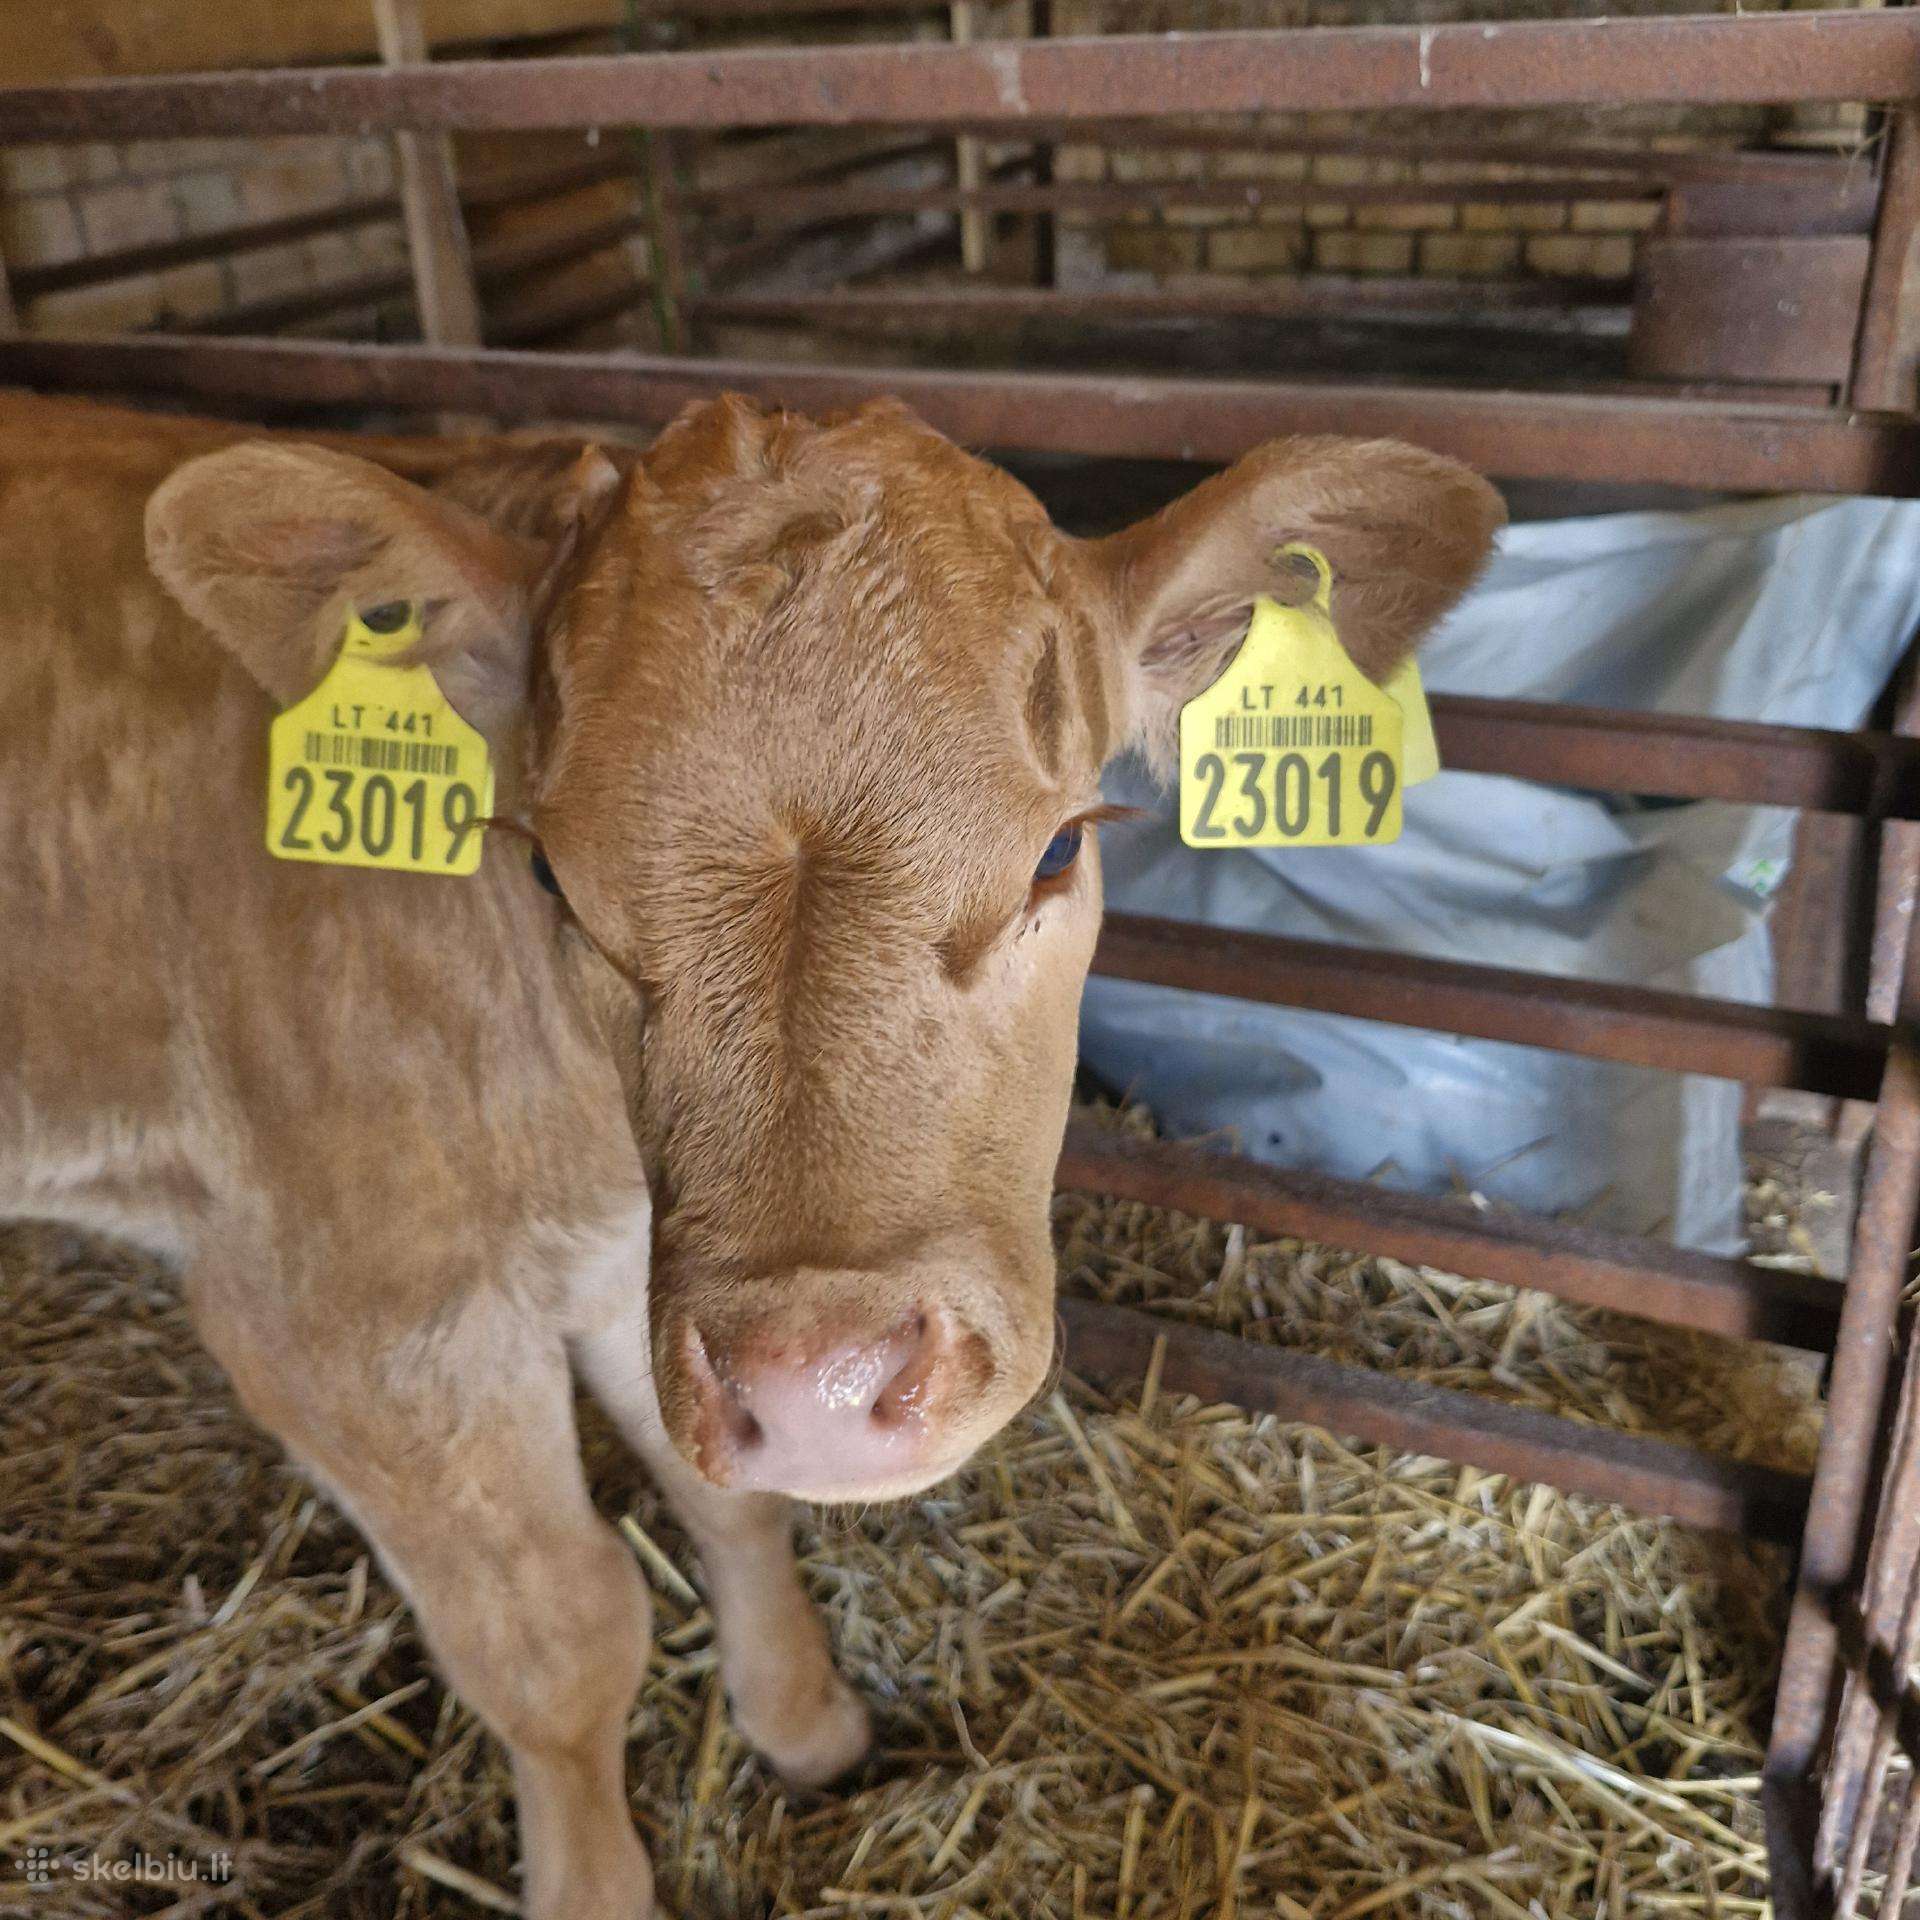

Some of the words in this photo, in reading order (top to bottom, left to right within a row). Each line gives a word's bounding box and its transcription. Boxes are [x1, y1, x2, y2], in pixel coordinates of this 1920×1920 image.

[332, 704, 366, 729] LT
[385, 710, 433, 737] 441
[1242, 685, 1274, 710] LT
[1295, 685, 1343, 709] 441
[280, 766, 477, 864] 23019
[1192, 750, 1396, 838] 23019
